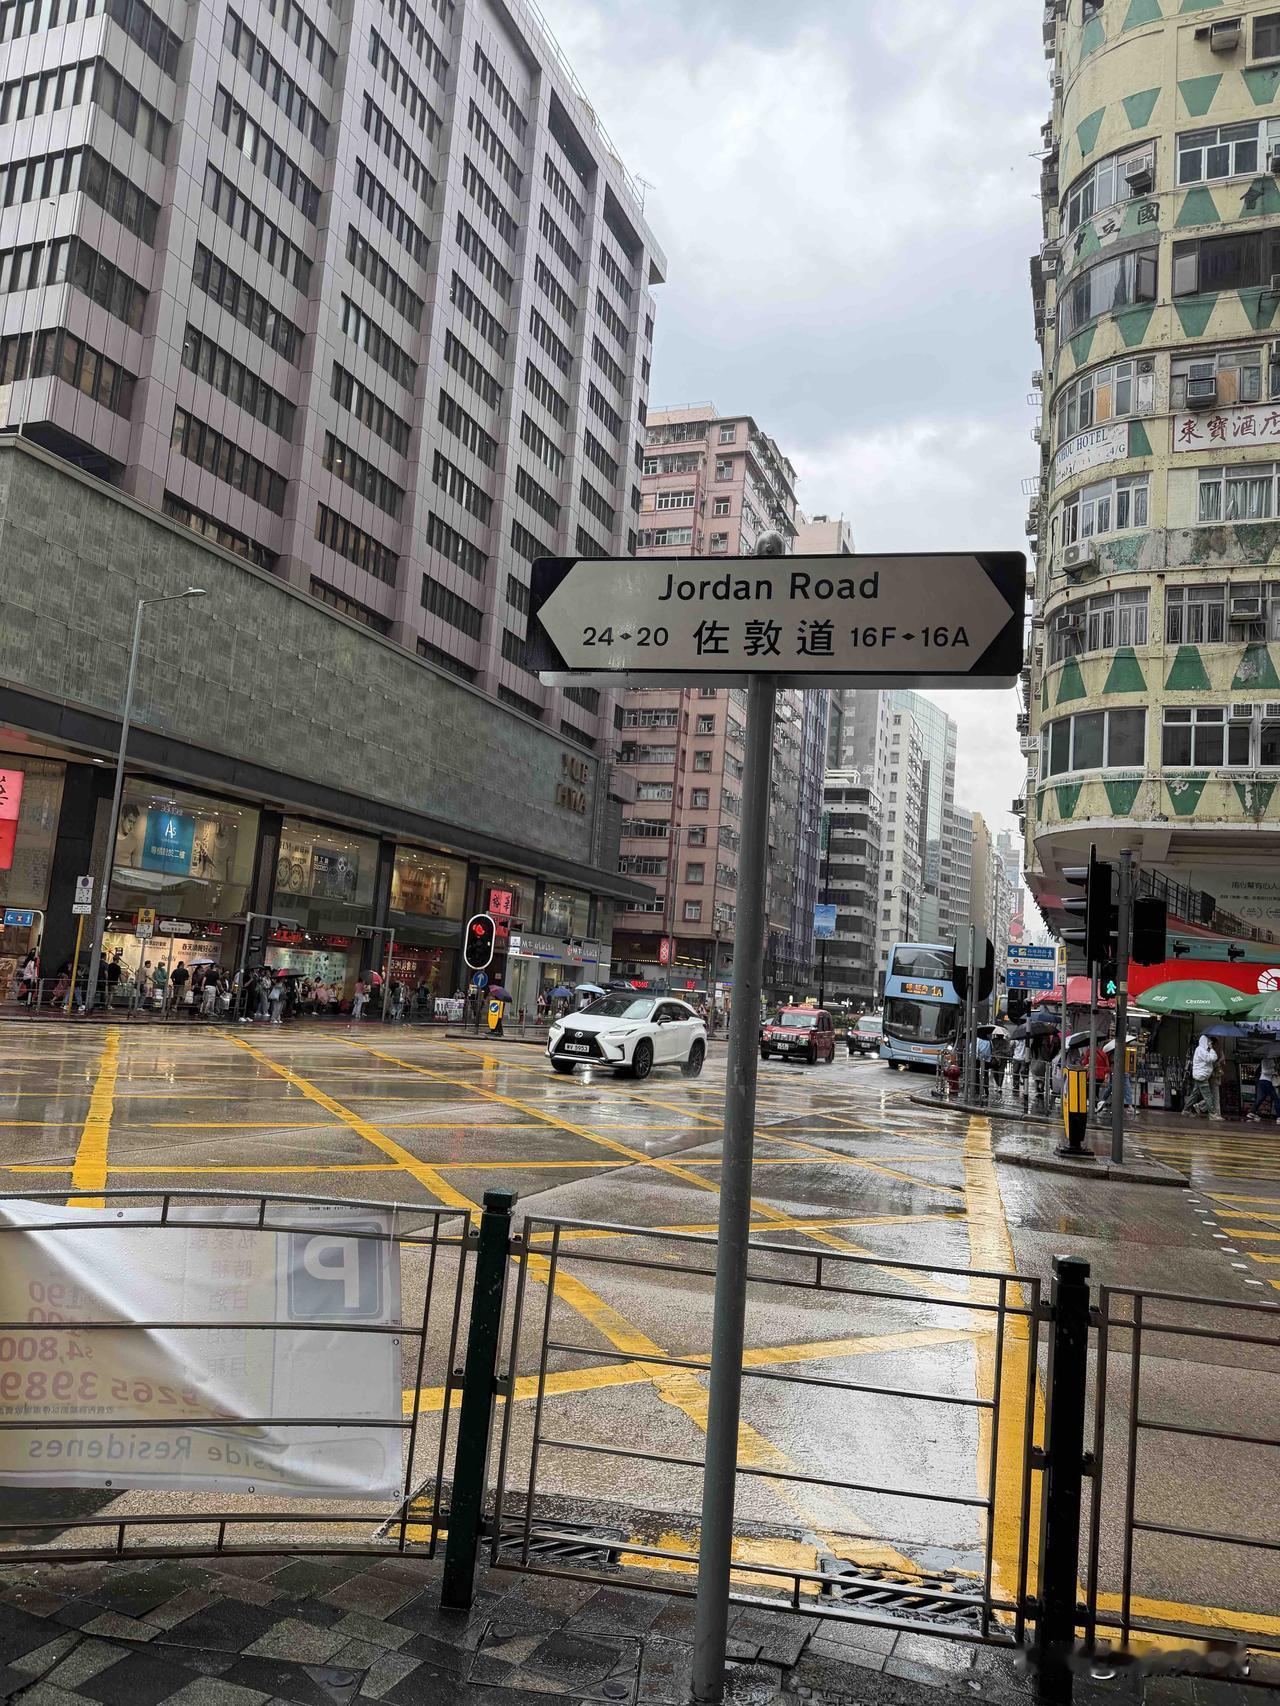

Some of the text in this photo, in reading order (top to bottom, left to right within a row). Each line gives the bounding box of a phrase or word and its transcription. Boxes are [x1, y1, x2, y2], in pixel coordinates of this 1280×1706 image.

[1076, 429, 1108, 451] HOTEL
[658, 571, 880, 601] Jordan Road
[582, 626, 669, 647] 24 20
[692, 619, 836, 656] 佐敦道
[850, 627, 970, 648] 16F 16A
